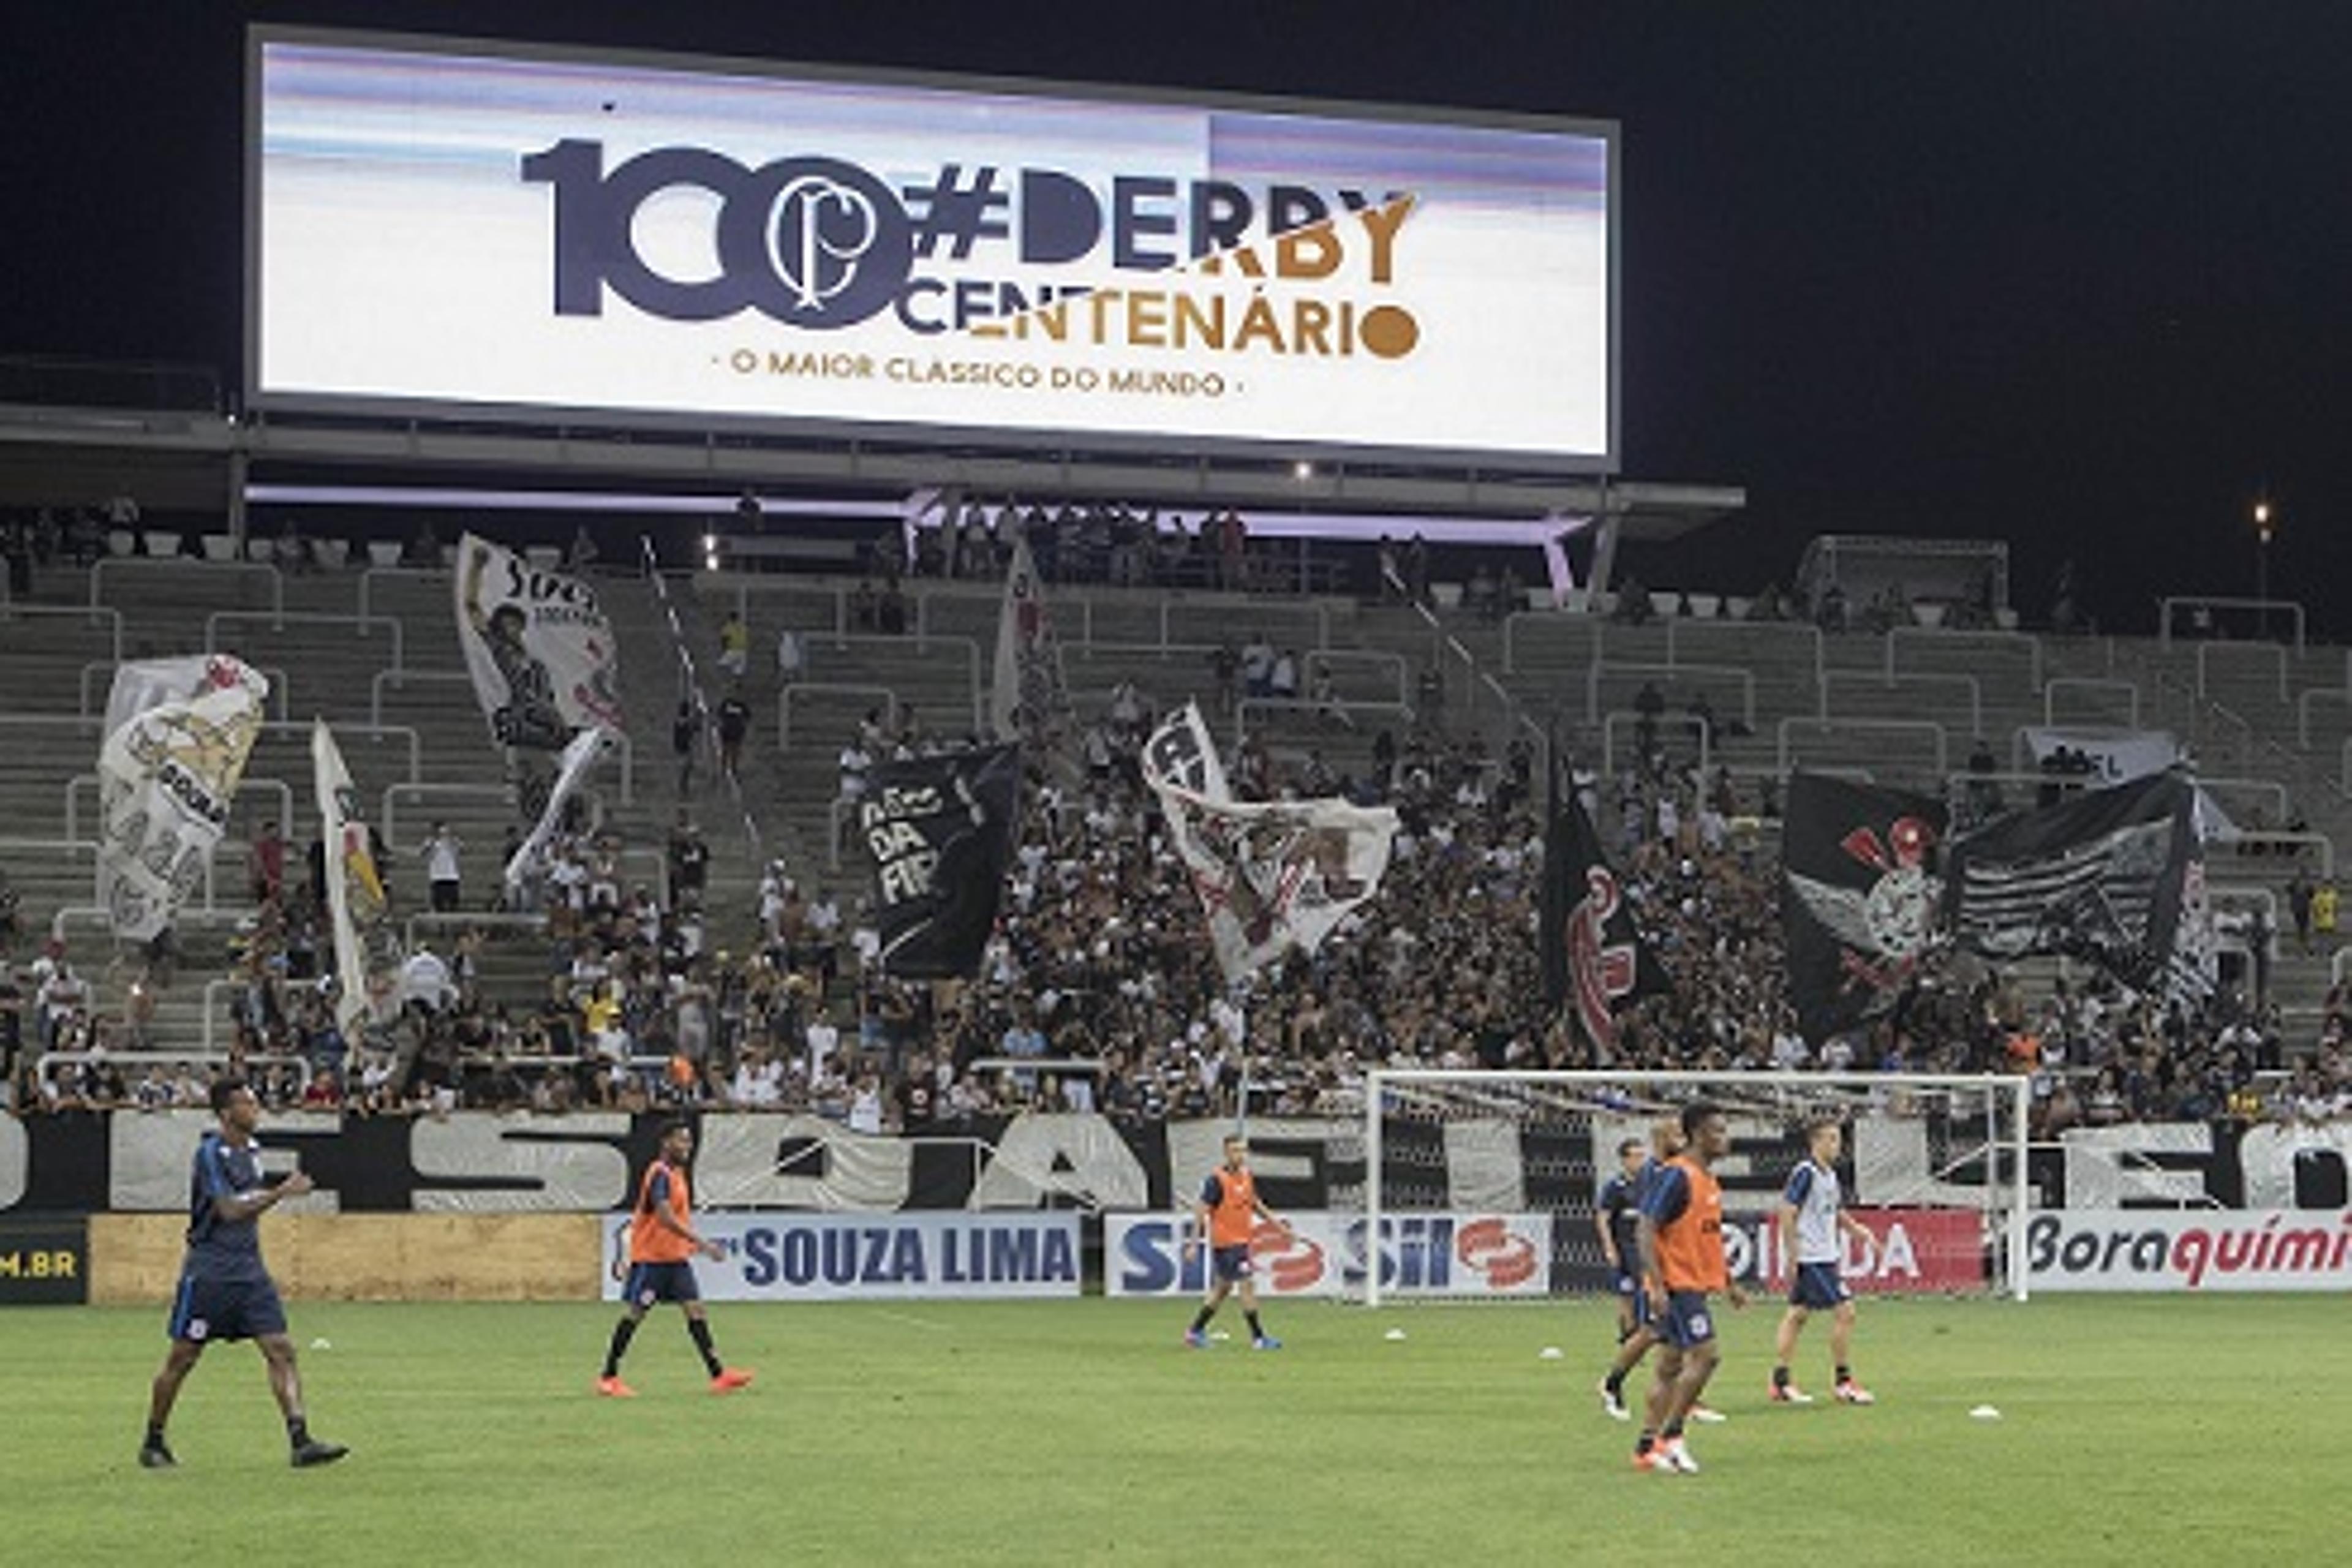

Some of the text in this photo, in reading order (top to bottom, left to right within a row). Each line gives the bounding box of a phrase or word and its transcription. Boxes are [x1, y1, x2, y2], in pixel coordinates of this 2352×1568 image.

[902, 164, 1416, 284] #DERBY
[731, 349, 757, 374] O
[769, 352, 874, 379] MAIOR
[1052, 367, 1099, 392] DO
[1107, 369, 1225, 398] MUNDO
[744, 1227, 927, 1286] SOUZA
[941, 1225, 1076, 1283] LIMA
[1121, 1221, 1205, 1291] Si
[1344, 1219, 1453, 1287] Sil
